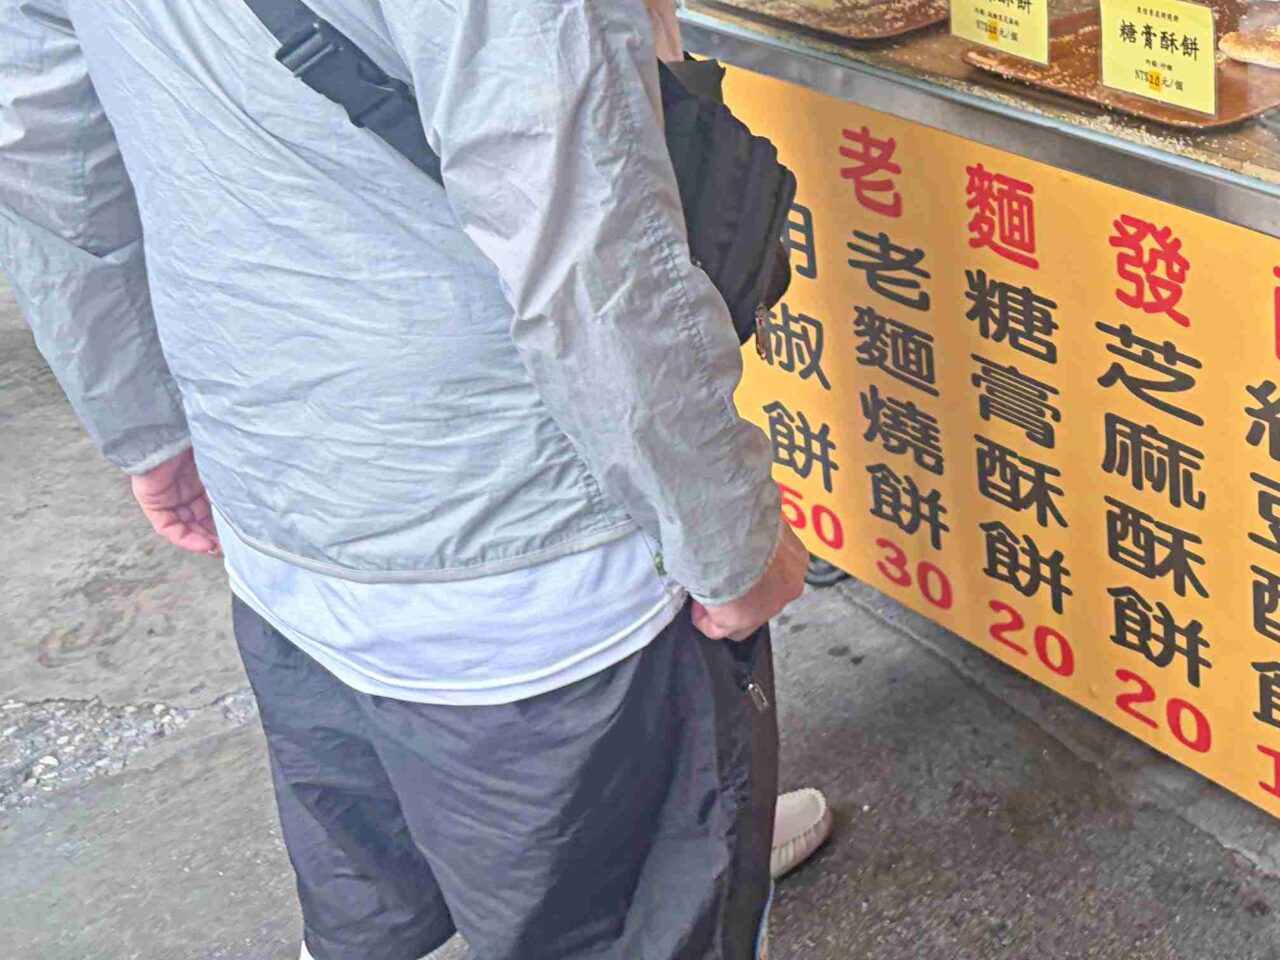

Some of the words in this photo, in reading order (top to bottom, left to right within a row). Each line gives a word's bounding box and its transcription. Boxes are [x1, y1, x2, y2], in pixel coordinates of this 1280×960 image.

[1119, 19, 1200, 62] 糖膏酥餅
[846, 230, 950, 551] 老麵燒餅
[964, 268, 1073, 615] 糖膏酥餅
[778, 482, 844, 550] 50
[1095, 321, 1212, 688] 芝麻酥餅
[875, 537, 954, 610] 30
[988, 599, 1075, 678] 20
[1114, 668, 1213, 753] 20
